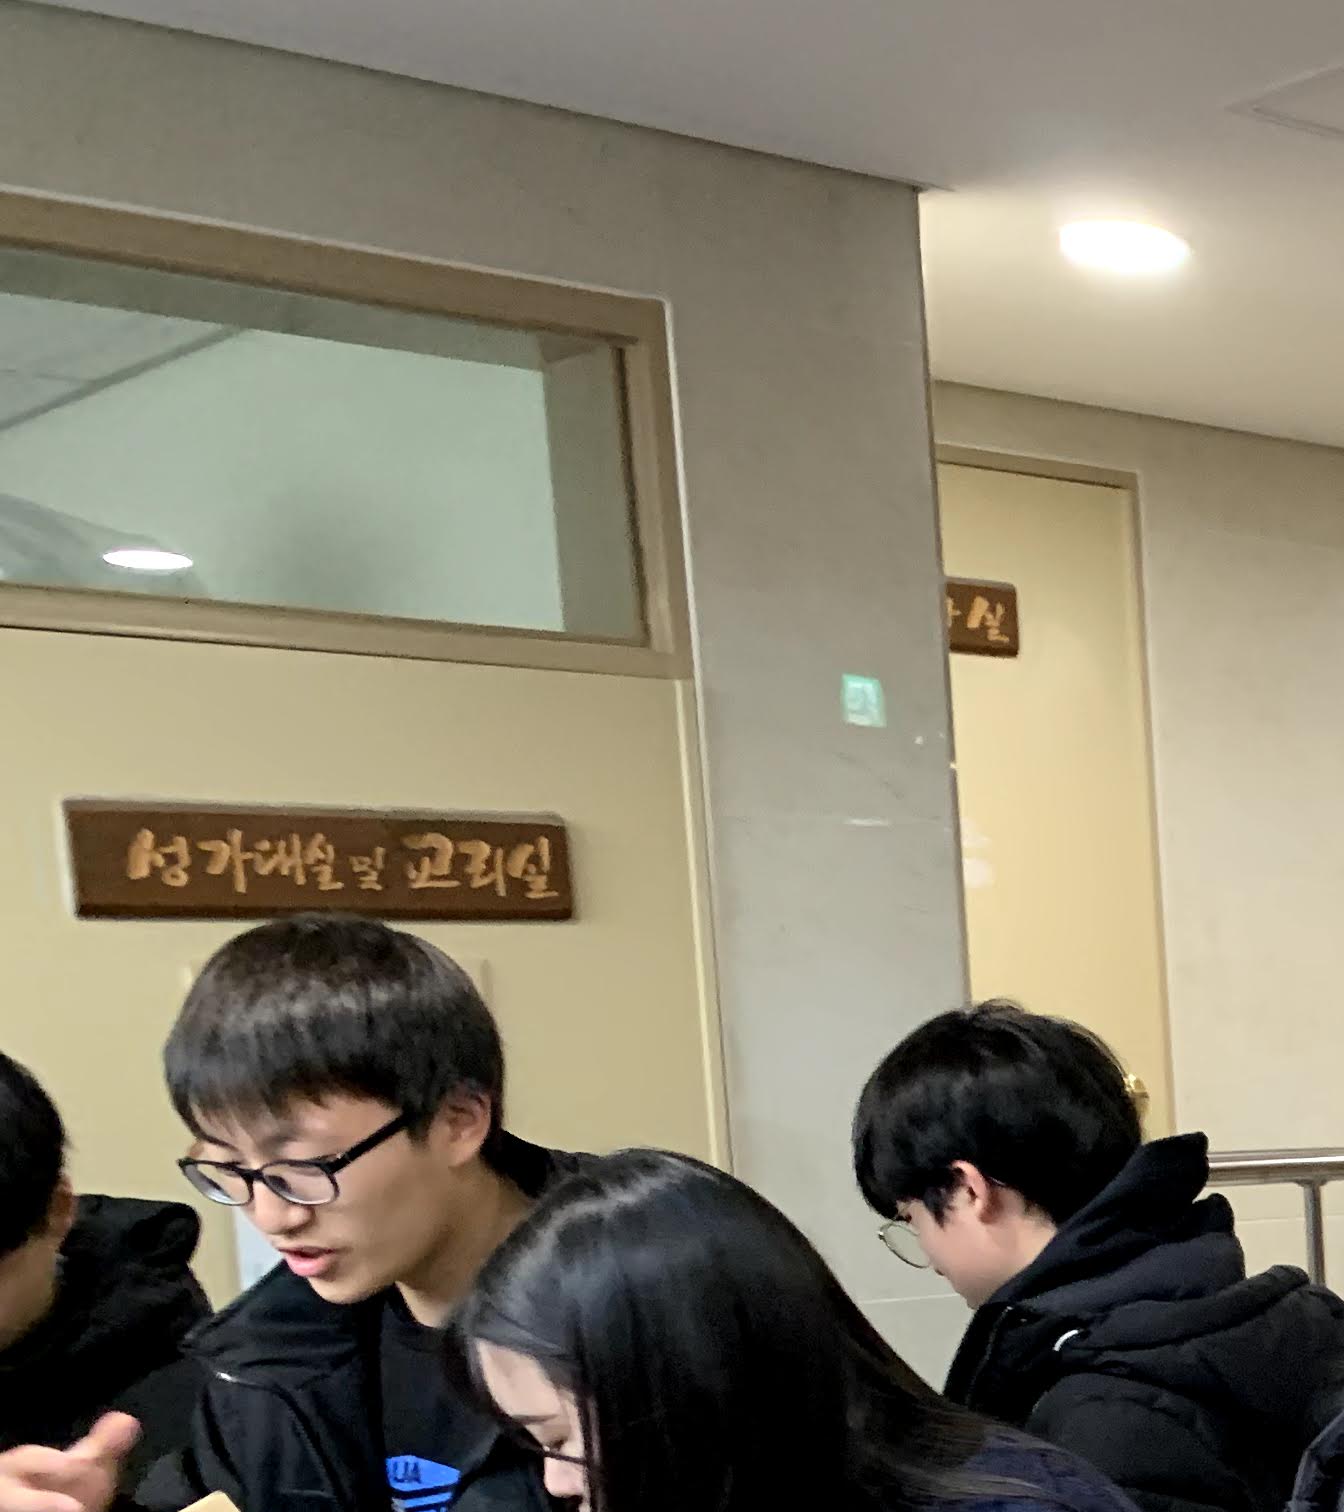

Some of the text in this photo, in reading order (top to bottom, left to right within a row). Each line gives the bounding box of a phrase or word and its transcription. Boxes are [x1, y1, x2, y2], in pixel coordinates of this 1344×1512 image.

[125, 828, 559, 899] 성가대실 및 교리실
